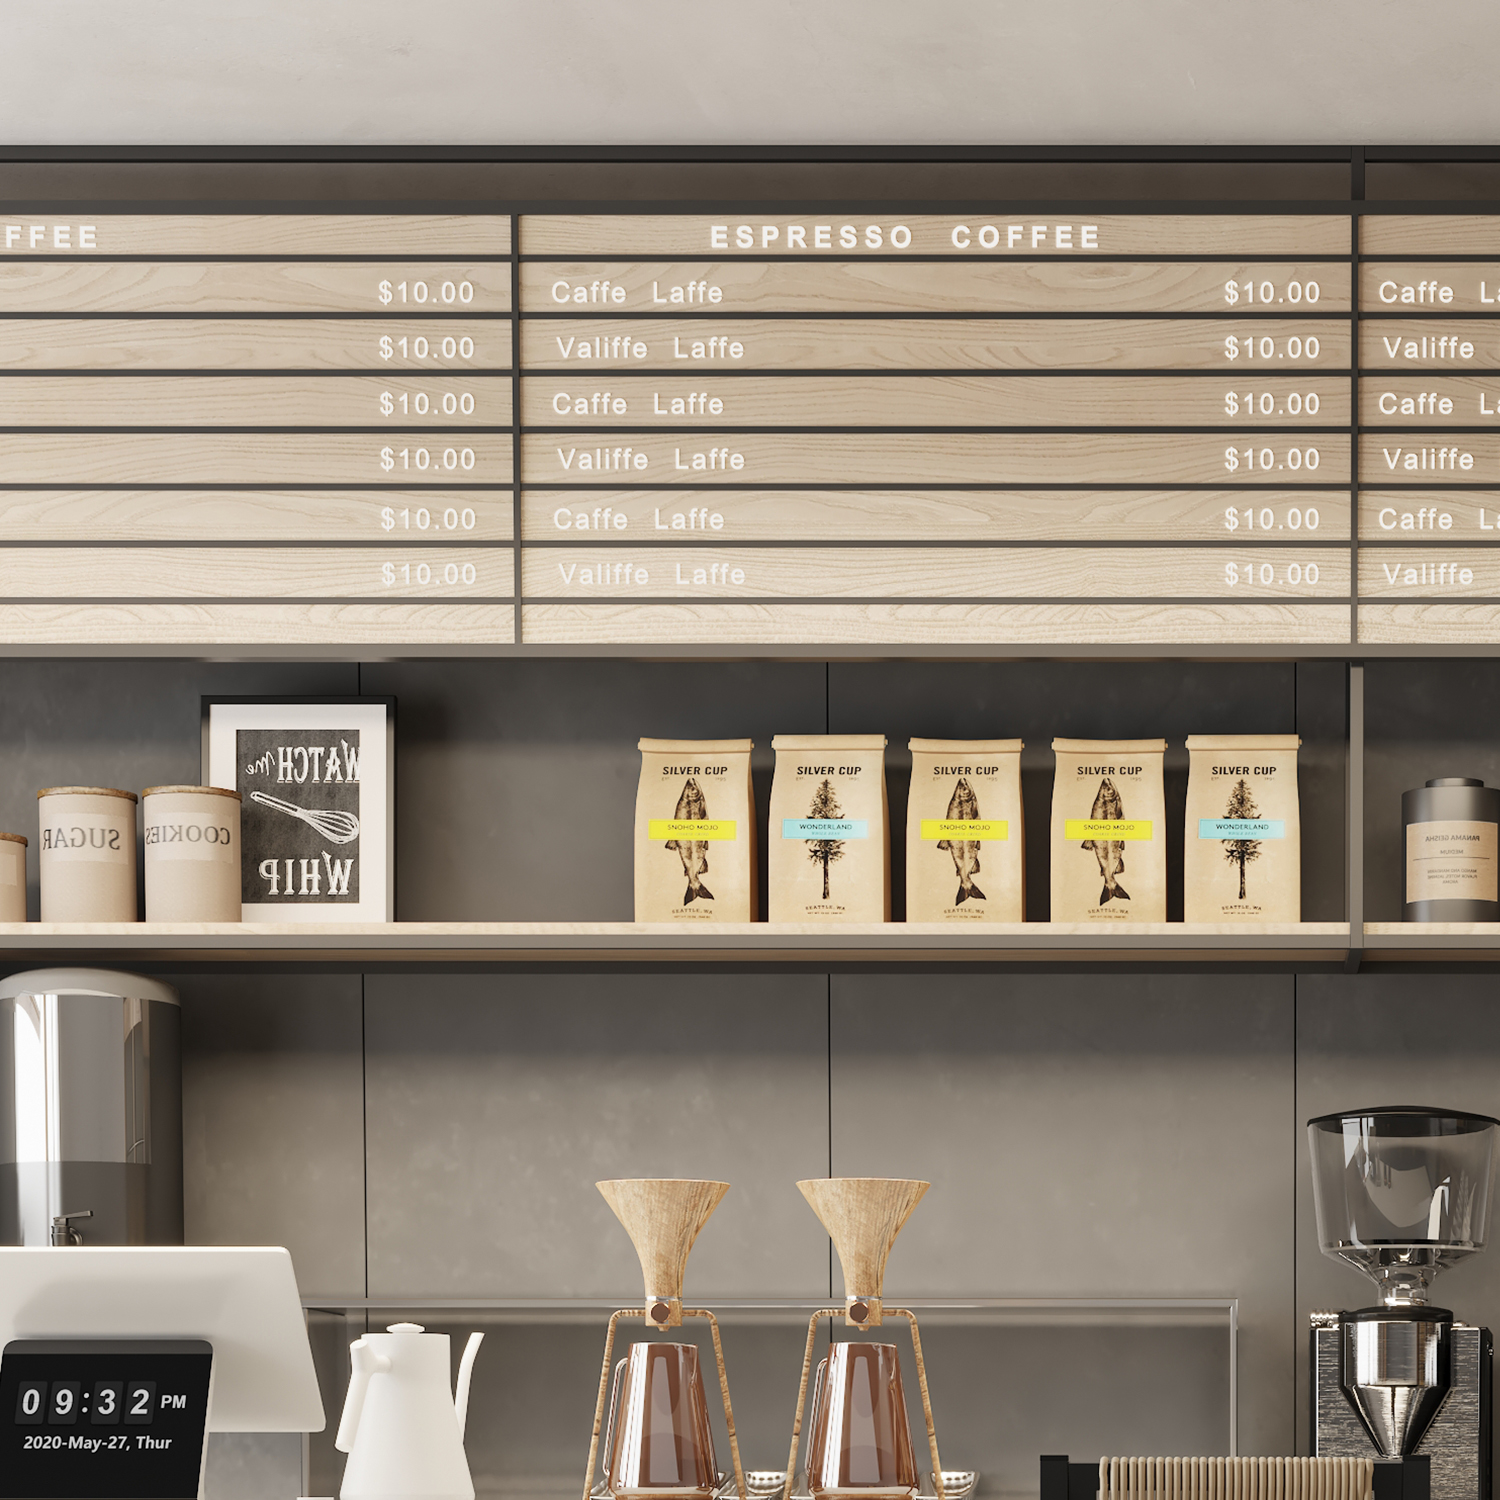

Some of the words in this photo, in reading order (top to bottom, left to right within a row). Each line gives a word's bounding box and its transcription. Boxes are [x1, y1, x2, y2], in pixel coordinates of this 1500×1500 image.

[710, 224, 912, 249] ESPRESSO
[951, 224, 1099, 249] COFFEE
[378, 279, 474, 306] $10.00
[551, 280, 626, 304] Caffe
[653, 280, 723, 304] Laffe
[1224, 279, 1320, 306] $10.00
[1378, 280, 1454, 304] Caffe
[378, 335, 474, 361] $10.00
[556, 336, 648, 359] Valiffe
[674, 336, 744, 359] Laffe
[1224, 334, 1320, 362] $10.00
[1382, 335, 1475, 359] Valiffe
[379, 391, 475, 417] $10.00
[552, 392, 627, 415] Caffe
[653, 392, 724, 415] Laffe
[1224, 390, 1320, 418] $10.00
[1378, 392, 1454, 415] Caffe
[380, 446, 475, 472] $10.00
[556, 447, 649, 470] Valiffe
[675, 447, 745, 470] Laffe
[1224, 446, 1320, 473] $10.00
[1382, 447, 1474, 471] Valiffe
[380, 506, 476, 533] $10.00
[553, 507, 628, 530] Caffe
[654, 507, 724, 531] Laffe
[1223, 505, 1320, 533] $10.00
[1378, 507, 1453, 531] Caffe
[381, 561, 477, 587] $10.00
[558, 562, 649, 585] Valiffe
[675, 562, 746, 585] Laffe
[1224, 561, 1320, 588] $10.00
[1381, 562, 1474, 586] Valiffe
[662, 766, 701, 775] SILVER
[704, 766, 728, 775] CUP
[796, 766, 835, 775] SILVER
[839, 766, 862, 775] CUP
[933, 766, 972, 775] SILVER
[976, 766, 999, 775] CUP
[1077, 766, 1115, 775] SILVER
[1119, 766, 1143, 775] CUP
[1211, 766, 1250, 775] SILVER
[1253, 766, 1277, 775] CUP
[697, 823, 719, 831] MOJO
[799, 823, 853, 831] WONDERLAND
[969, 823, 991, 831] MOJO
[1113, 823, 1135, 831] MOJO
[1215, 823, 1269, 831] WONDERLAND
[21, 1388, 149, 1416] 09:32
[160, 1394, 187, 1409] PM
[23, 1435, 130, 1452] 2020-May-27,
[136, 1435, 173, 1450] Thur
